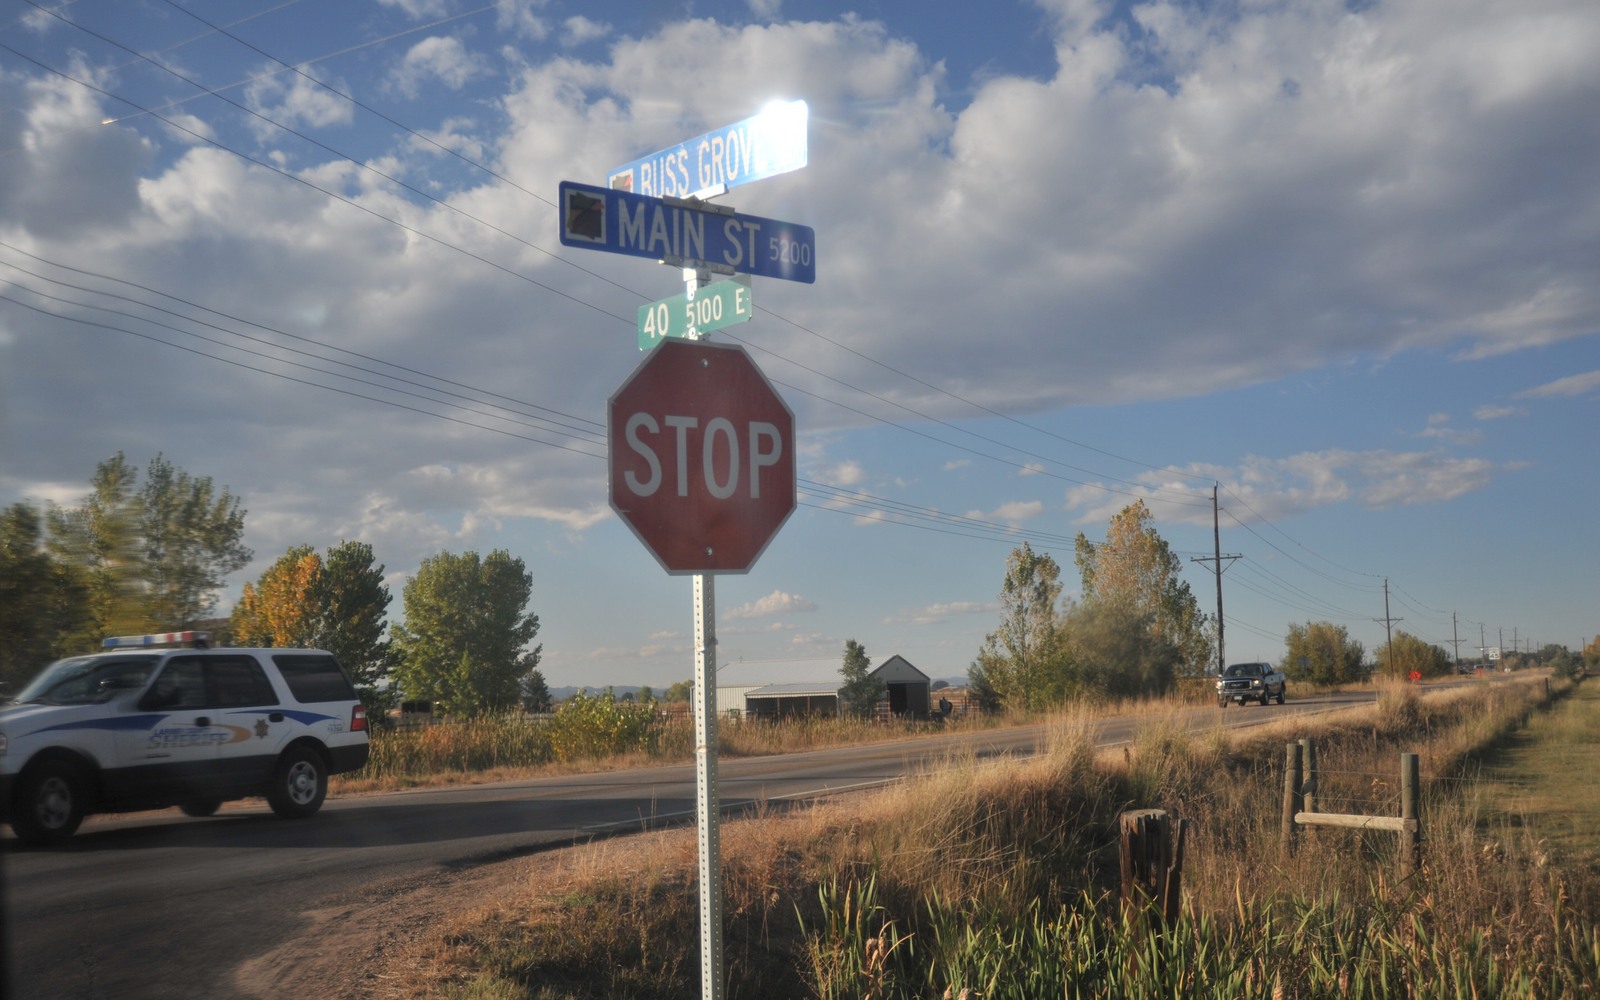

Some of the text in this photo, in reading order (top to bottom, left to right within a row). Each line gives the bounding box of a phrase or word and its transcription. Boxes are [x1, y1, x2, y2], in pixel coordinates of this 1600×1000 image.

[618, 198, 811, 268] MAIN ST 5200
[643, 287, 746, 339] 40 5100 E
[624, 412, 783, 499] STOP
